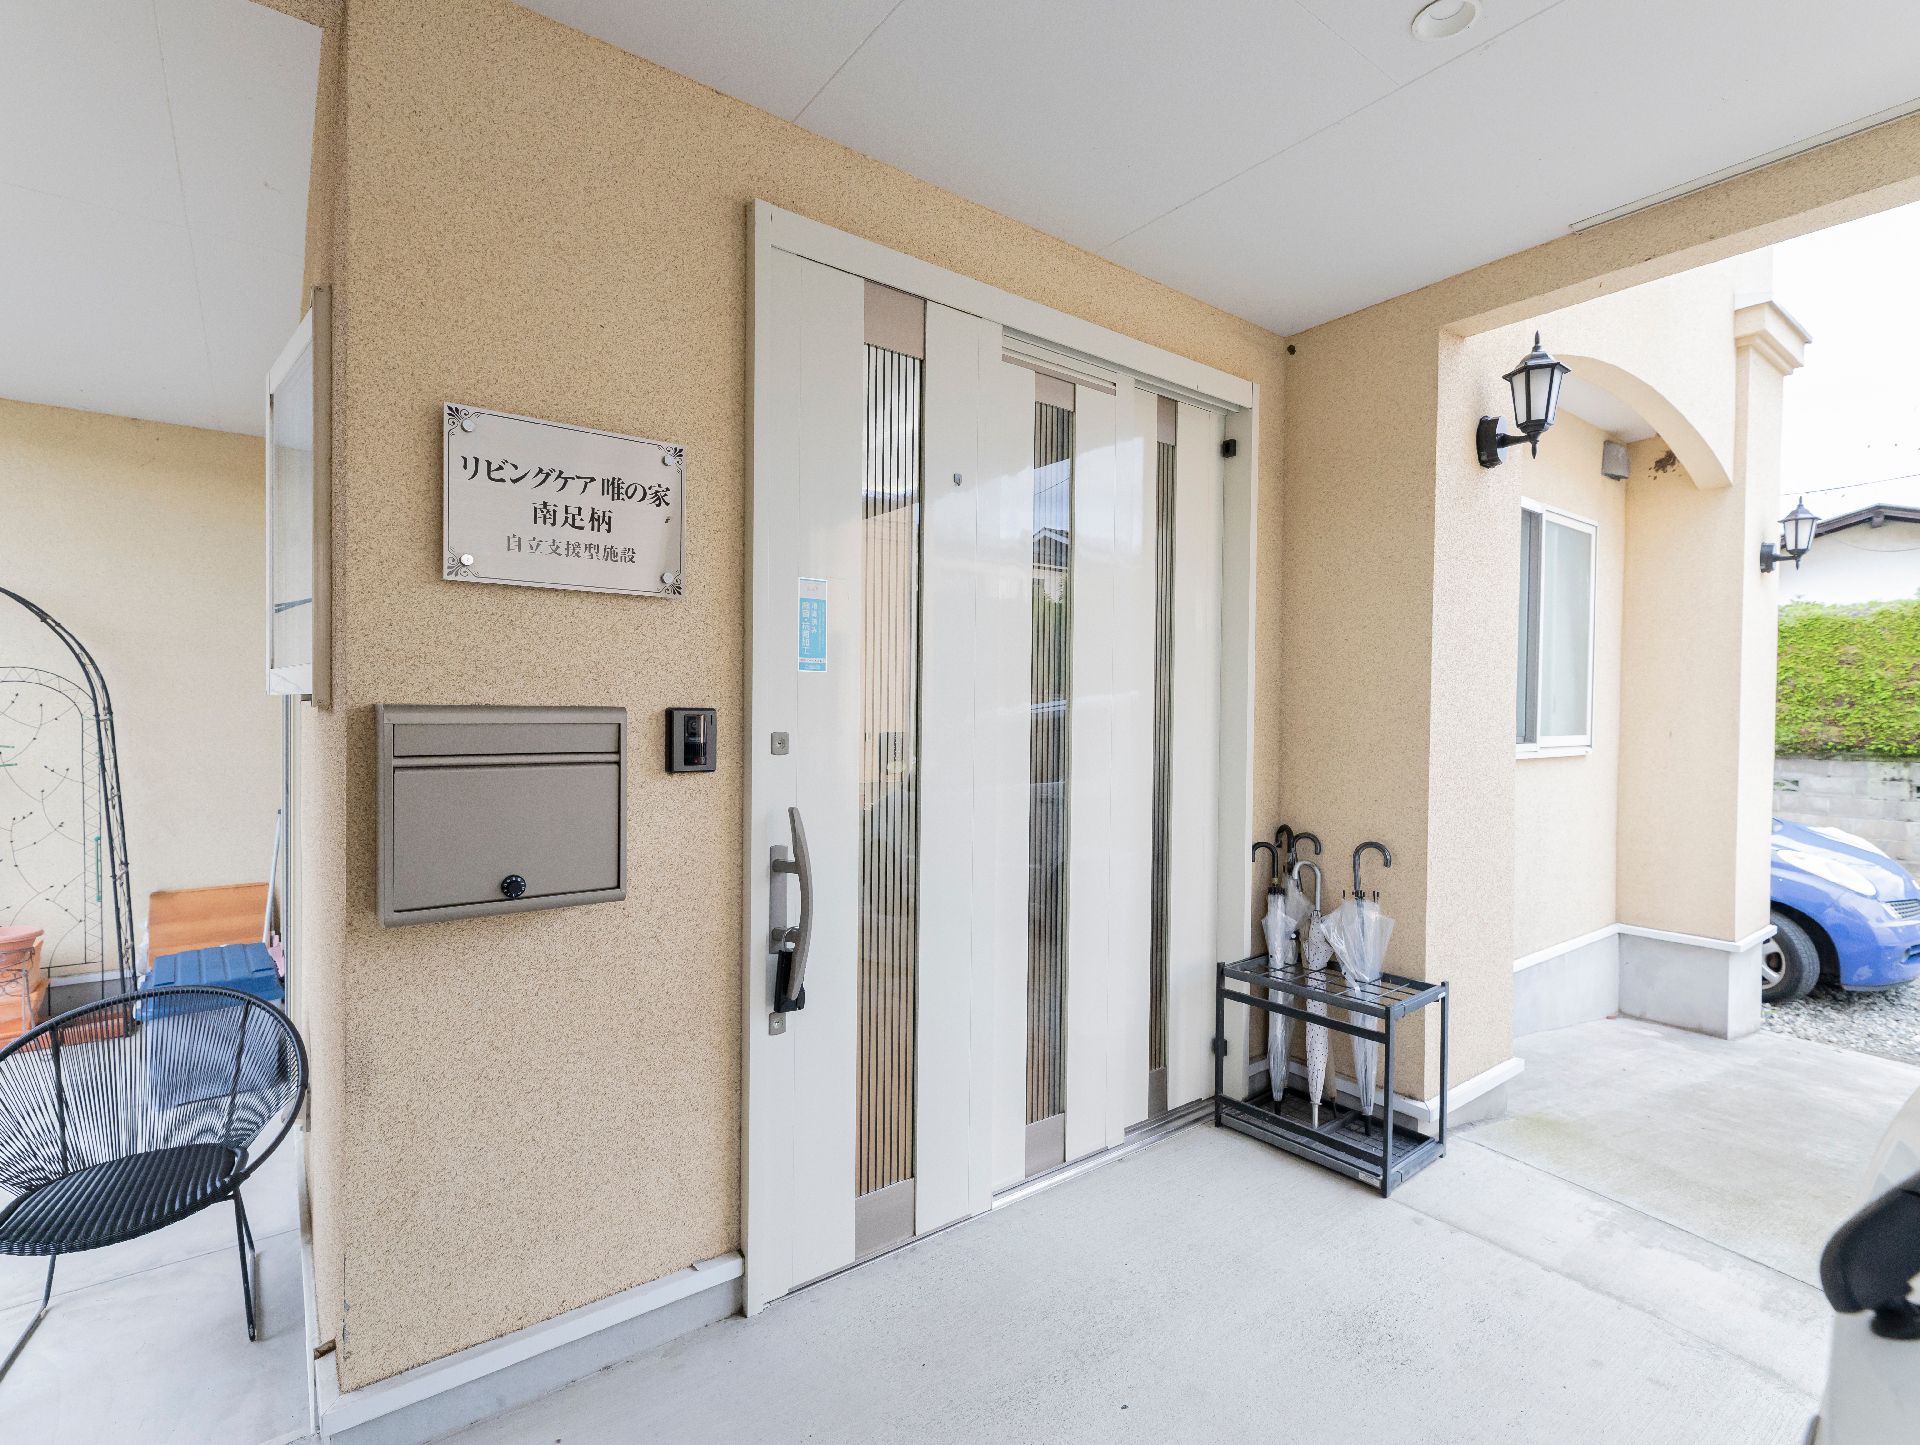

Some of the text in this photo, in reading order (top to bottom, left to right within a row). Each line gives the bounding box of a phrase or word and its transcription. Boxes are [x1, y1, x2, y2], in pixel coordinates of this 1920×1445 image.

[461, 455, 670, 507] リビングケア 唯の家
[532, 500, 614, 534] 南足柄
[506, 533, 637, 565] 自立支援型施設
